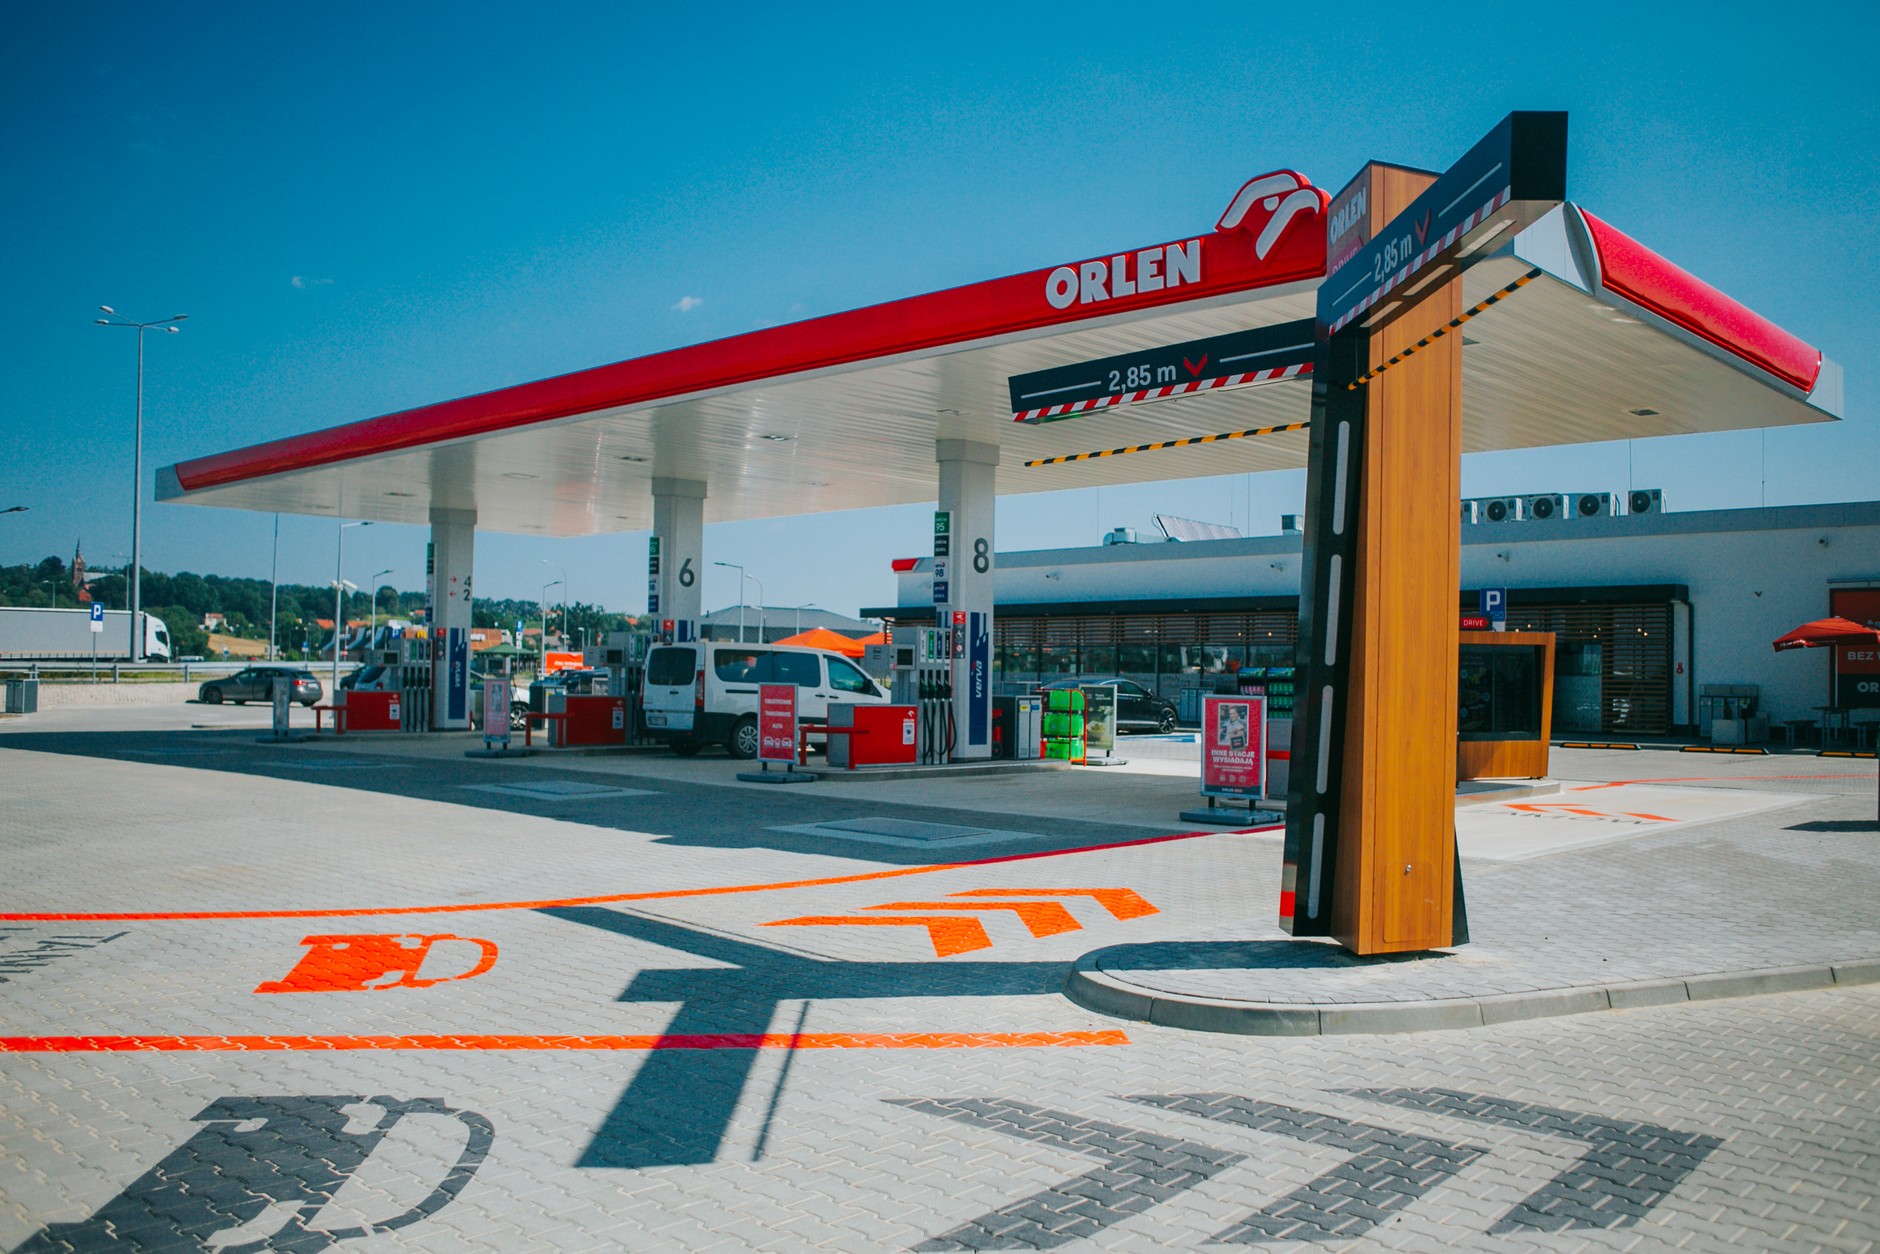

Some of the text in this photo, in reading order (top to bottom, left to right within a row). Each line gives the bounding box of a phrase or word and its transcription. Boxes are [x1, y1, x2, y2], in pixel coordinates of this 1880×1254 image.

[1330, 186, 1367, 245] ORLEN
[1374, 233, 1413, 283] 2,85 m
[1046, 239, 1201, 310] ORLEN
[1108, 364, 1177, 394] 2,85 m
[936, 522, 945, 531] 95
[973, 537, 990, 574] 8
[679, 558, 695, 588] 6
[935, 569, 944, 578] 98
[463, 576, 472, 588] 4
[463, 588, 471, 602] 2
[1486, 591, 1501, 611] P
[93, 604, 102, 620] P
[1463, 619, 1484, 627] DRIVE
[1847, 651, 1874, 661] BEZ
[975, 660, 983, 698] verva
[1857, 682, 1880, 693] OR
[1213, 757, 1253, 766] WYSIADAJĄ
